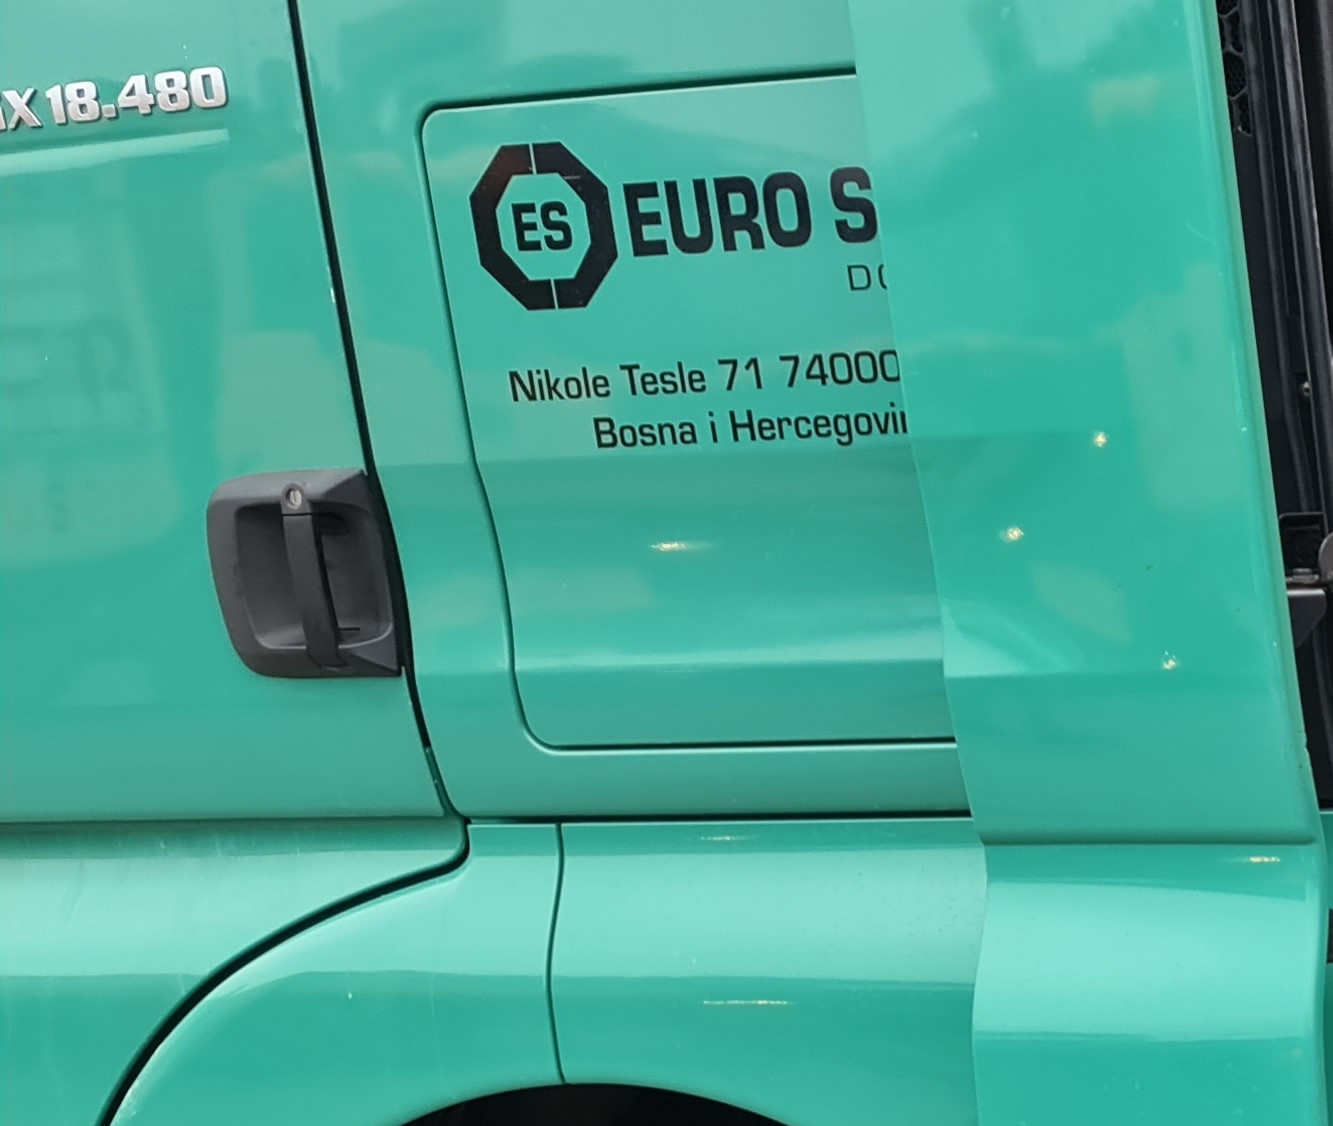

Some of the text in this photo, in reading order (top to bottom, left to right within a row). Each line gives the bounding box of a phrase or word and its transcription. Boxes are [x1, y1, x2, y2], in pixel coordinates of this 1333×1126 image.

[45, 66, 228, 125] 18.480
[511, 200, 573, 252] ES
[623, 171, 812, 258] EURO
[508, 349, 901, 402] Nikole Tesle 71 74000
[592, 415, 698, 449] Bosna
[707, 411, 719, 443] i
